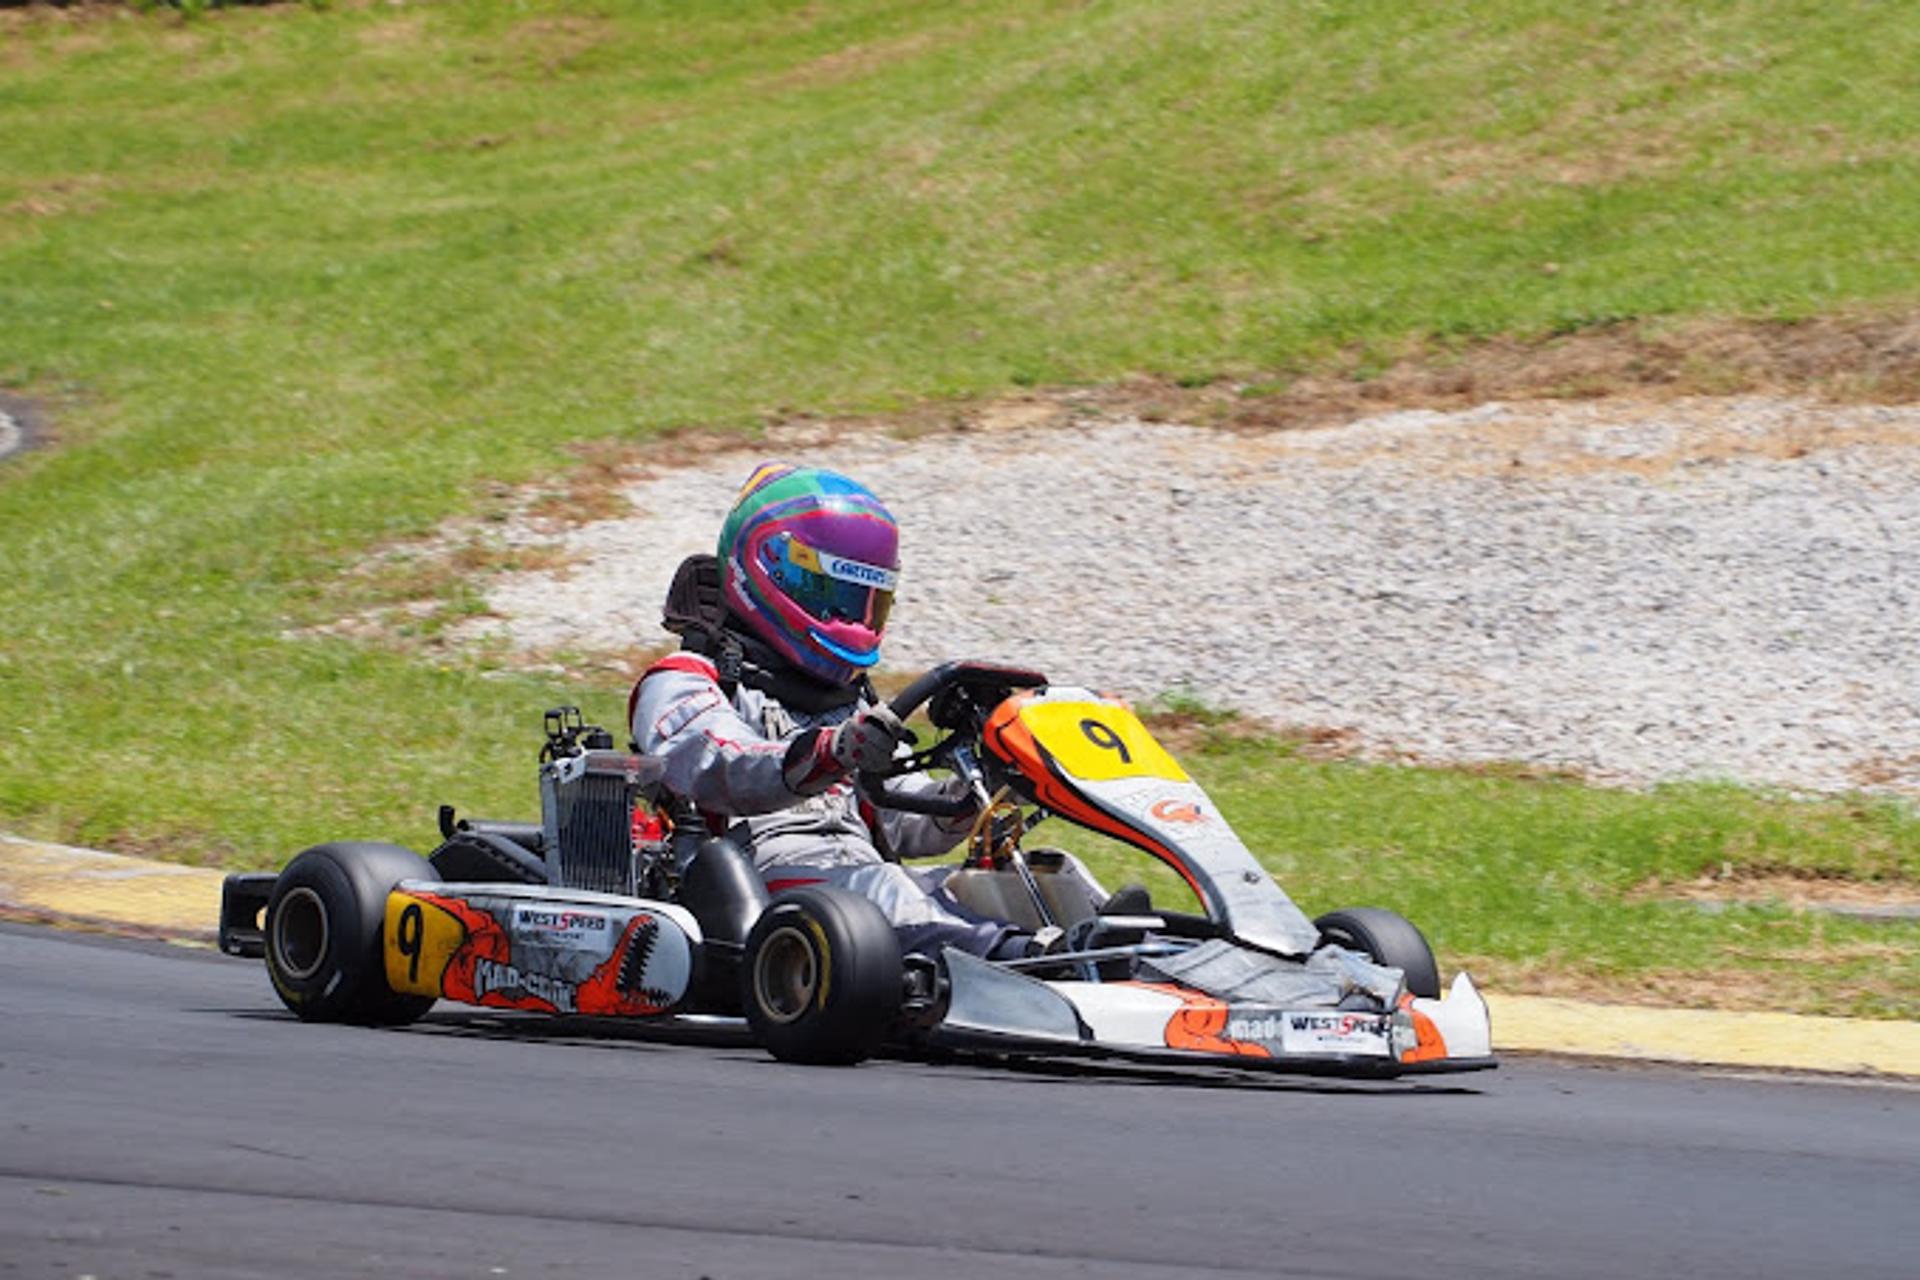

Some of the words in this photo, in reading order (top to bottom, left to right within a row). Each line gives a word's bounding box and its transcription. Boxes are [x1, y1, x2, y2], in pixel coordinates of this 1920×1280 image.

[1079, 718, 1132, 764] 9
[399, 903, 423, 983] 9
[1231, 1016, 1276, 1039] mad
